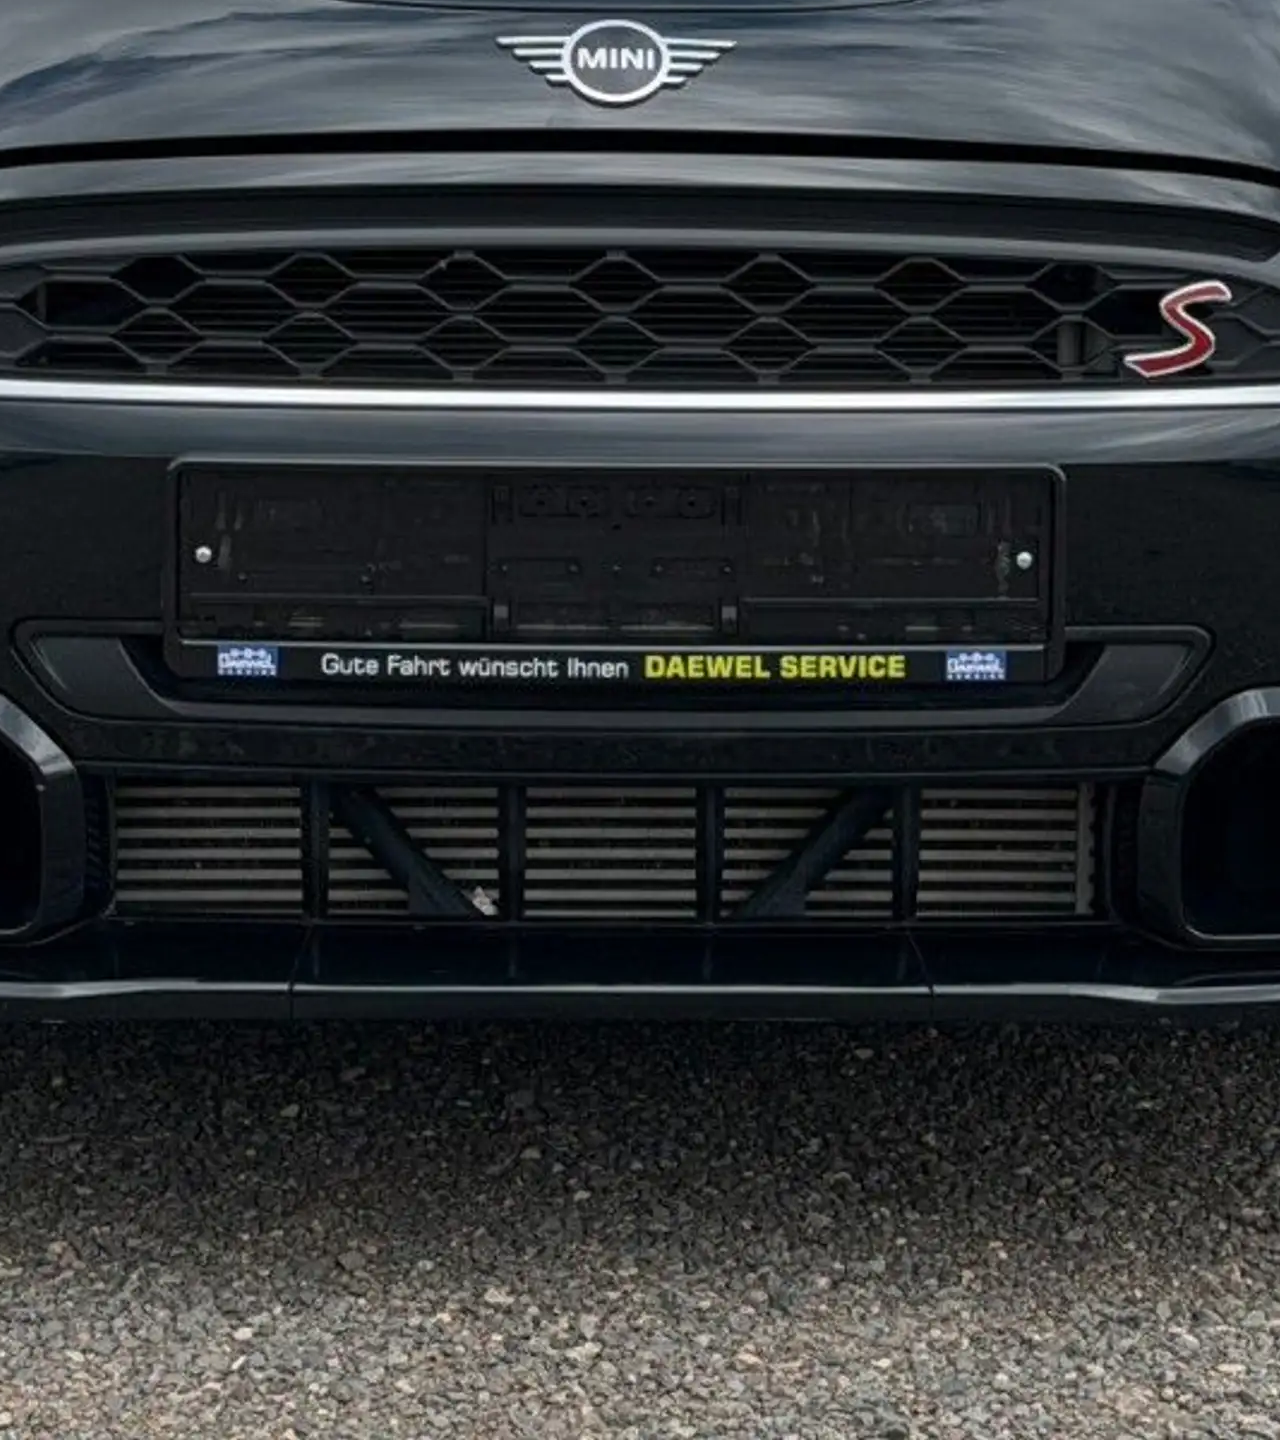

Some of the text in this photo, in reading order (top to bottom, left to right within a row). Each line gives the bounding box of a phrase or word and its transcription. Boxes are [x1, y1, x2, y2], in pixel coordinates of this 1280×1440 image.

[577, 47, 656, 70] MINI
[1123, 280, 1232, 378] S
[321, 652, 906, 679] Gute Fahrt wünscht Ihnen DAEWEL SERVICE
